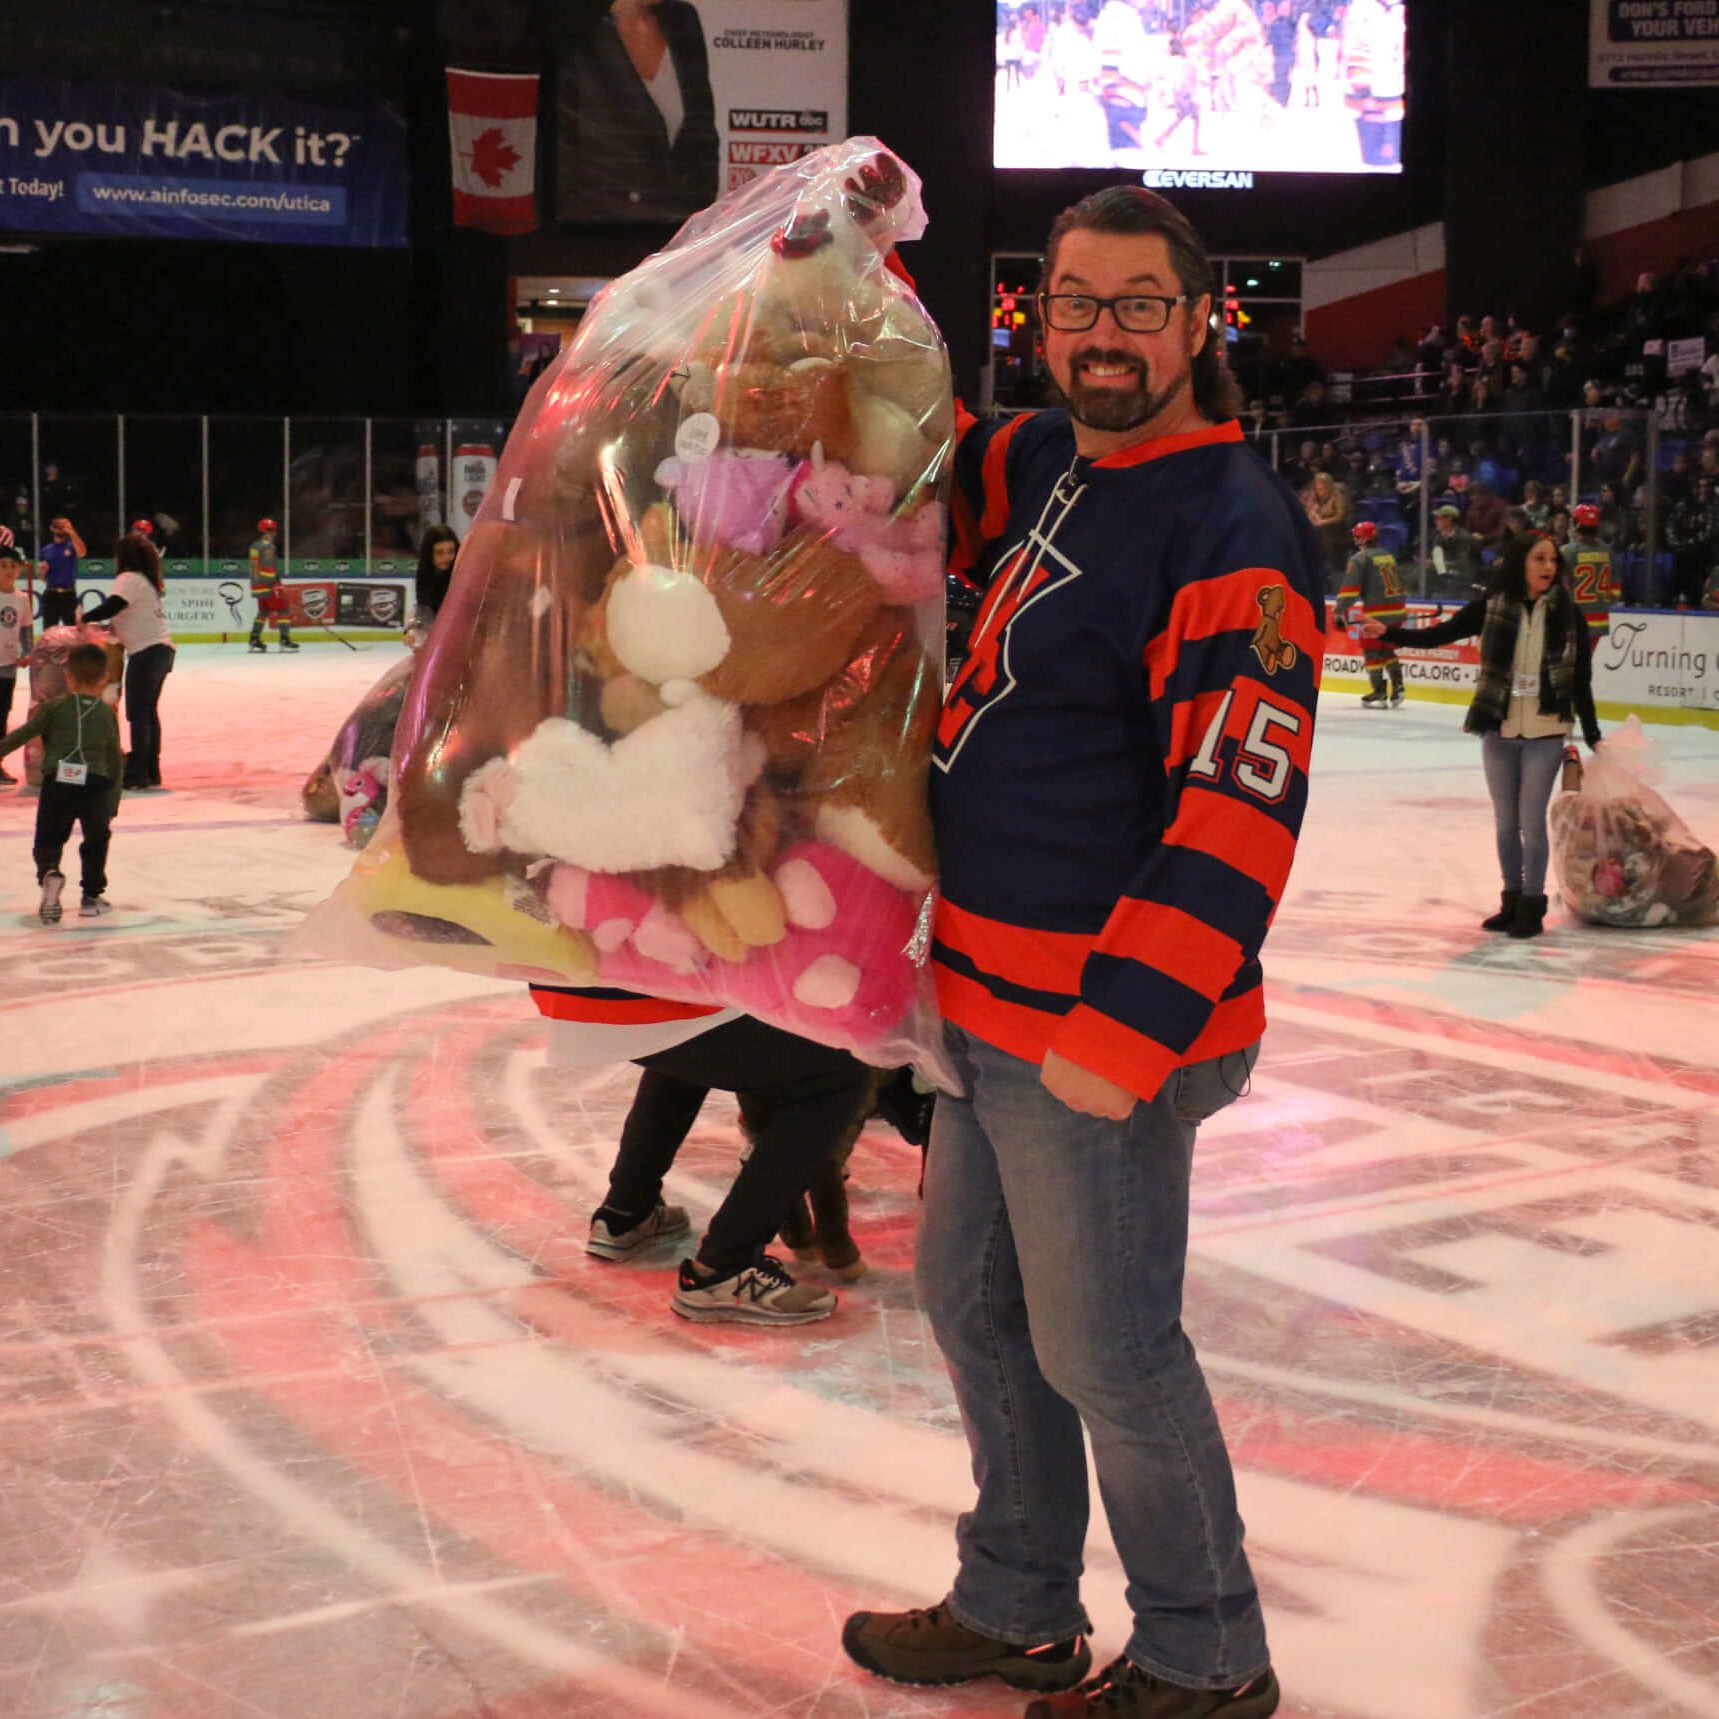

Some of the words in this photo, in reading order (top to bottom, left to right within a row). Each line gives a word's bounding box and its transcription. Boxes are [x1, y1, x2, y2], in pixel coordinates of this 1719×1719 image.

[1631, 19, 1680, 37] YOUR
[713, 37, 772, 49] COLLEEN
[774, 38, 825, 51] HURLEY
[730, 112, 797, 128] WUTR
[33, 119, 126, 157] you
[142, 119, 283, 163] HACK
[730, 144, 799, 163] WFXV
[9, 177, 64, 202] Today!
[93, 185, 331, 212] www.ainfosec.com/utica
[1574, 563, 1611, 603] 24
[1605, 622, 1706, 679] Turning
[1648, 684, 1694, 697] RESORT
[1187, 688, 1300, 802] 15
